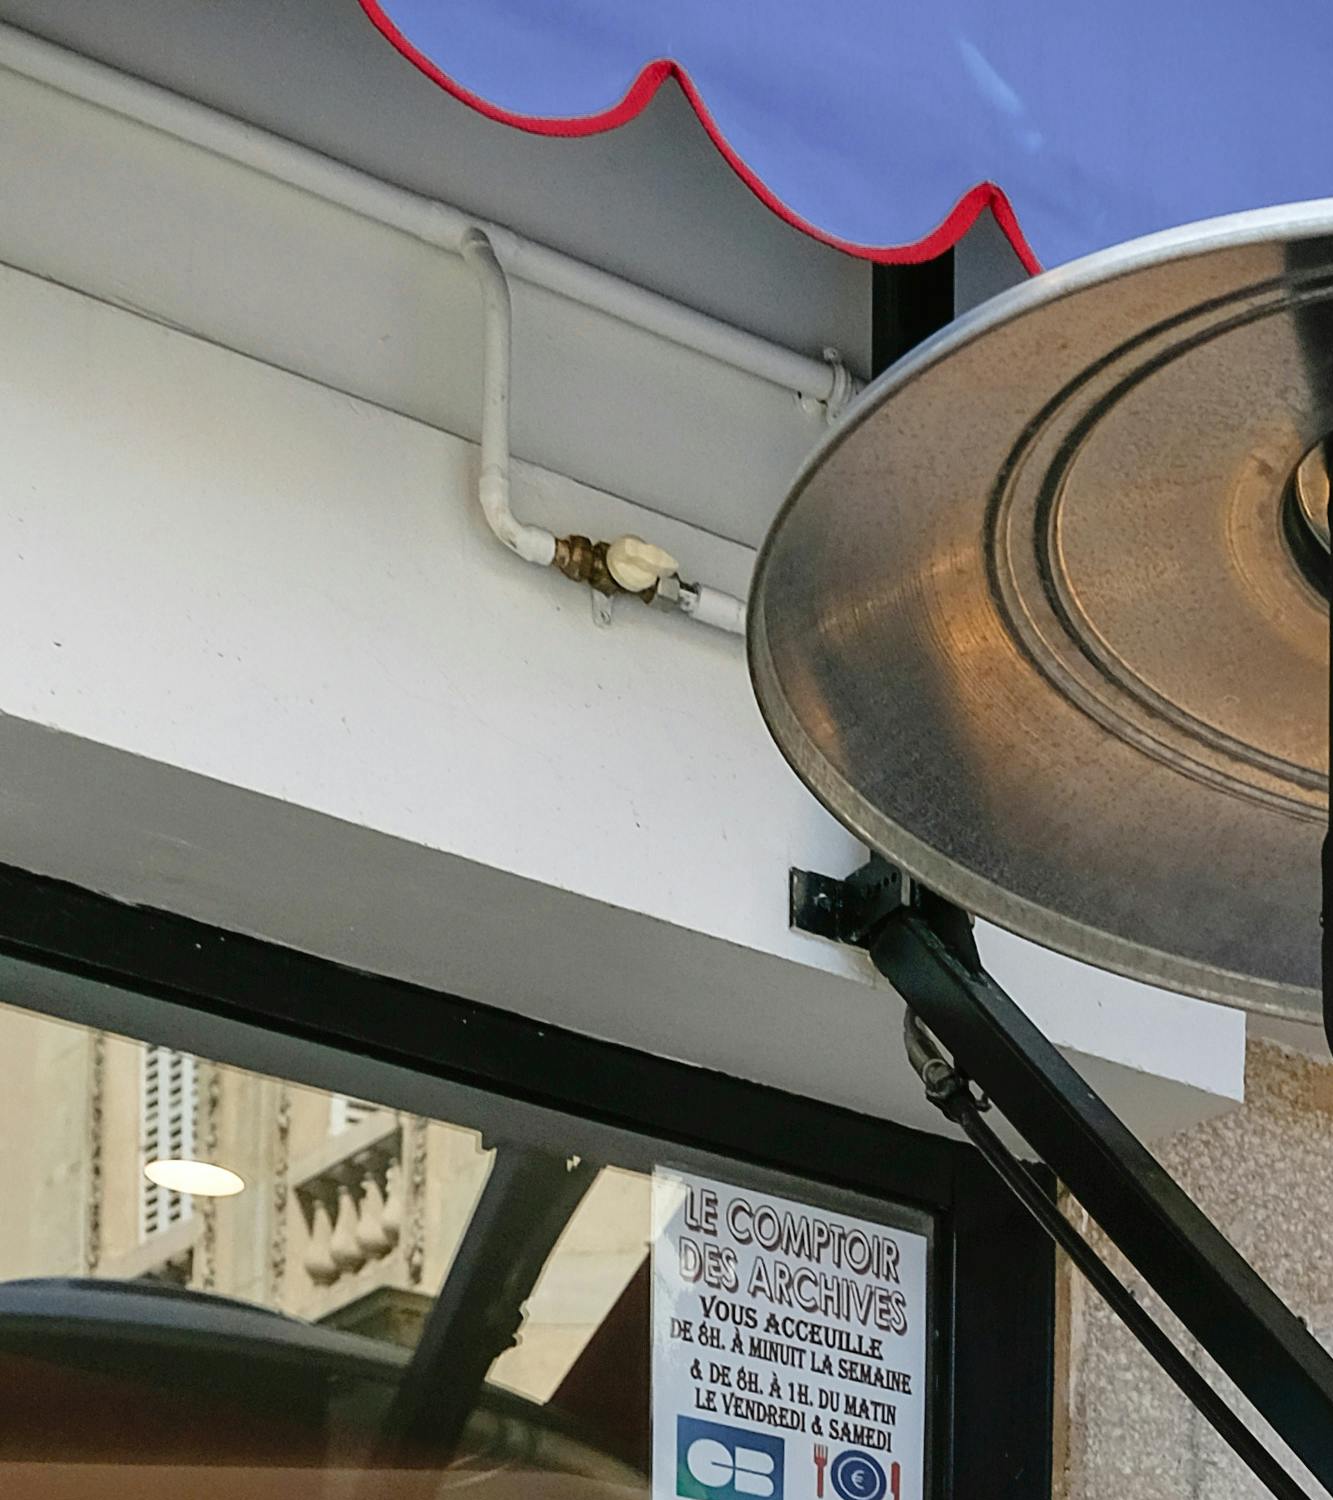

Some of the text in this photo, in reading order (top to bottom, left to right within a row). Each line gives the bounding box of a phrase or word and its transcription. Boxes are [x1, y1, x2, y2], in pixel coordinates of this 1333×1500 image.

[684, 1184, 901, 1283] LE COMPTOIR
[679, 1236, 908, 1336] DES ARCHIVES
[670, 1317, 913, 1395] DE 8H. À MINUIT LA SEMAINE
[700, 1295, 884, 1361] VOUS ACCEUILLE
[690, 1358, 896, 1426] & DE 8H. À 1H. DU MATIN
[694, 1387, 893, 1454] LE VENDREDI & SAMEDI
